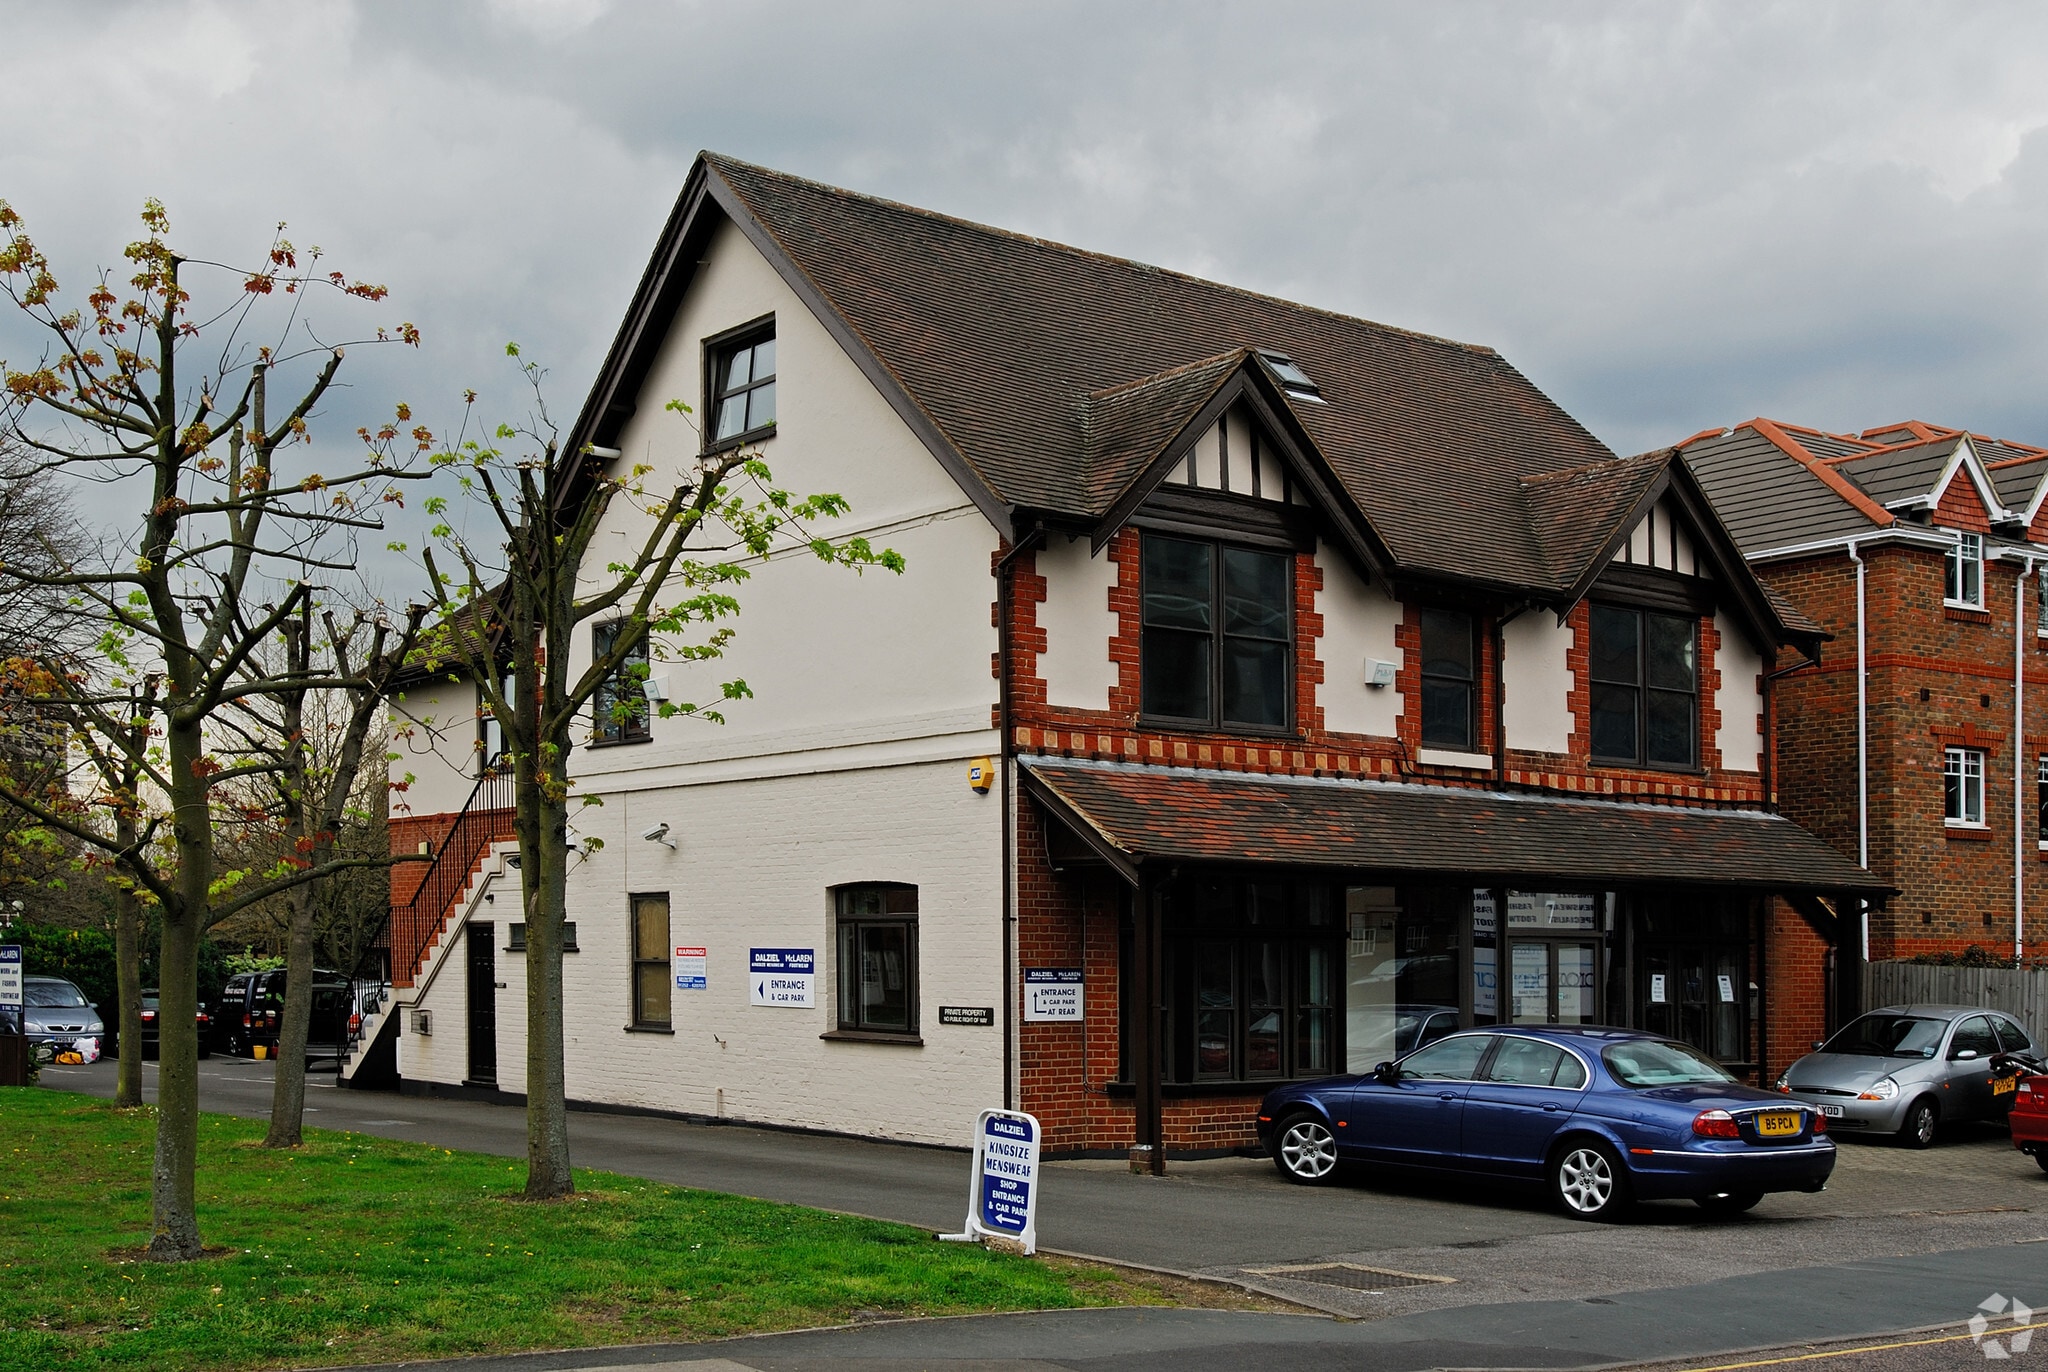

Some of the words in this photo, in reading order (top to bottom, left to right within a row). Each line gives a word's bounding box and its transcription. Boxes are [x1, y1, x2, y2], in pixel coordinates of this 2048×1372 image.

[1545, 901, 1555, 924] 7
[755, 953, 780, 962] DALZIEL
[785, 954, 813, 963] McLAREN
[771, 980, 805, 990] ENTRANCE
[1, 992, 19, 1000] FOOTWEAR
[771, 993, 775, 1001] &
[791, 994, 805, 1002] PARK
[944, 1008, 961, 1016] PRIVATE
[961, 1009, 986, 1017] PROPERTY
[994, 1122, 1026, 1137] DALZIEL
[1766, 1117, 1777, 1130] B5
[1778, 1117, 1794, 1129] PCA
[989, 1141, 1030, 1160] KINGSIZE
[1000, 1179, 1017, 1191] SHOP
[992, 1190, 1025, 1205] ENTRANCE
[988, 1201, 994, 1210] &
[995, 1203, 1010, 1213] CAR
